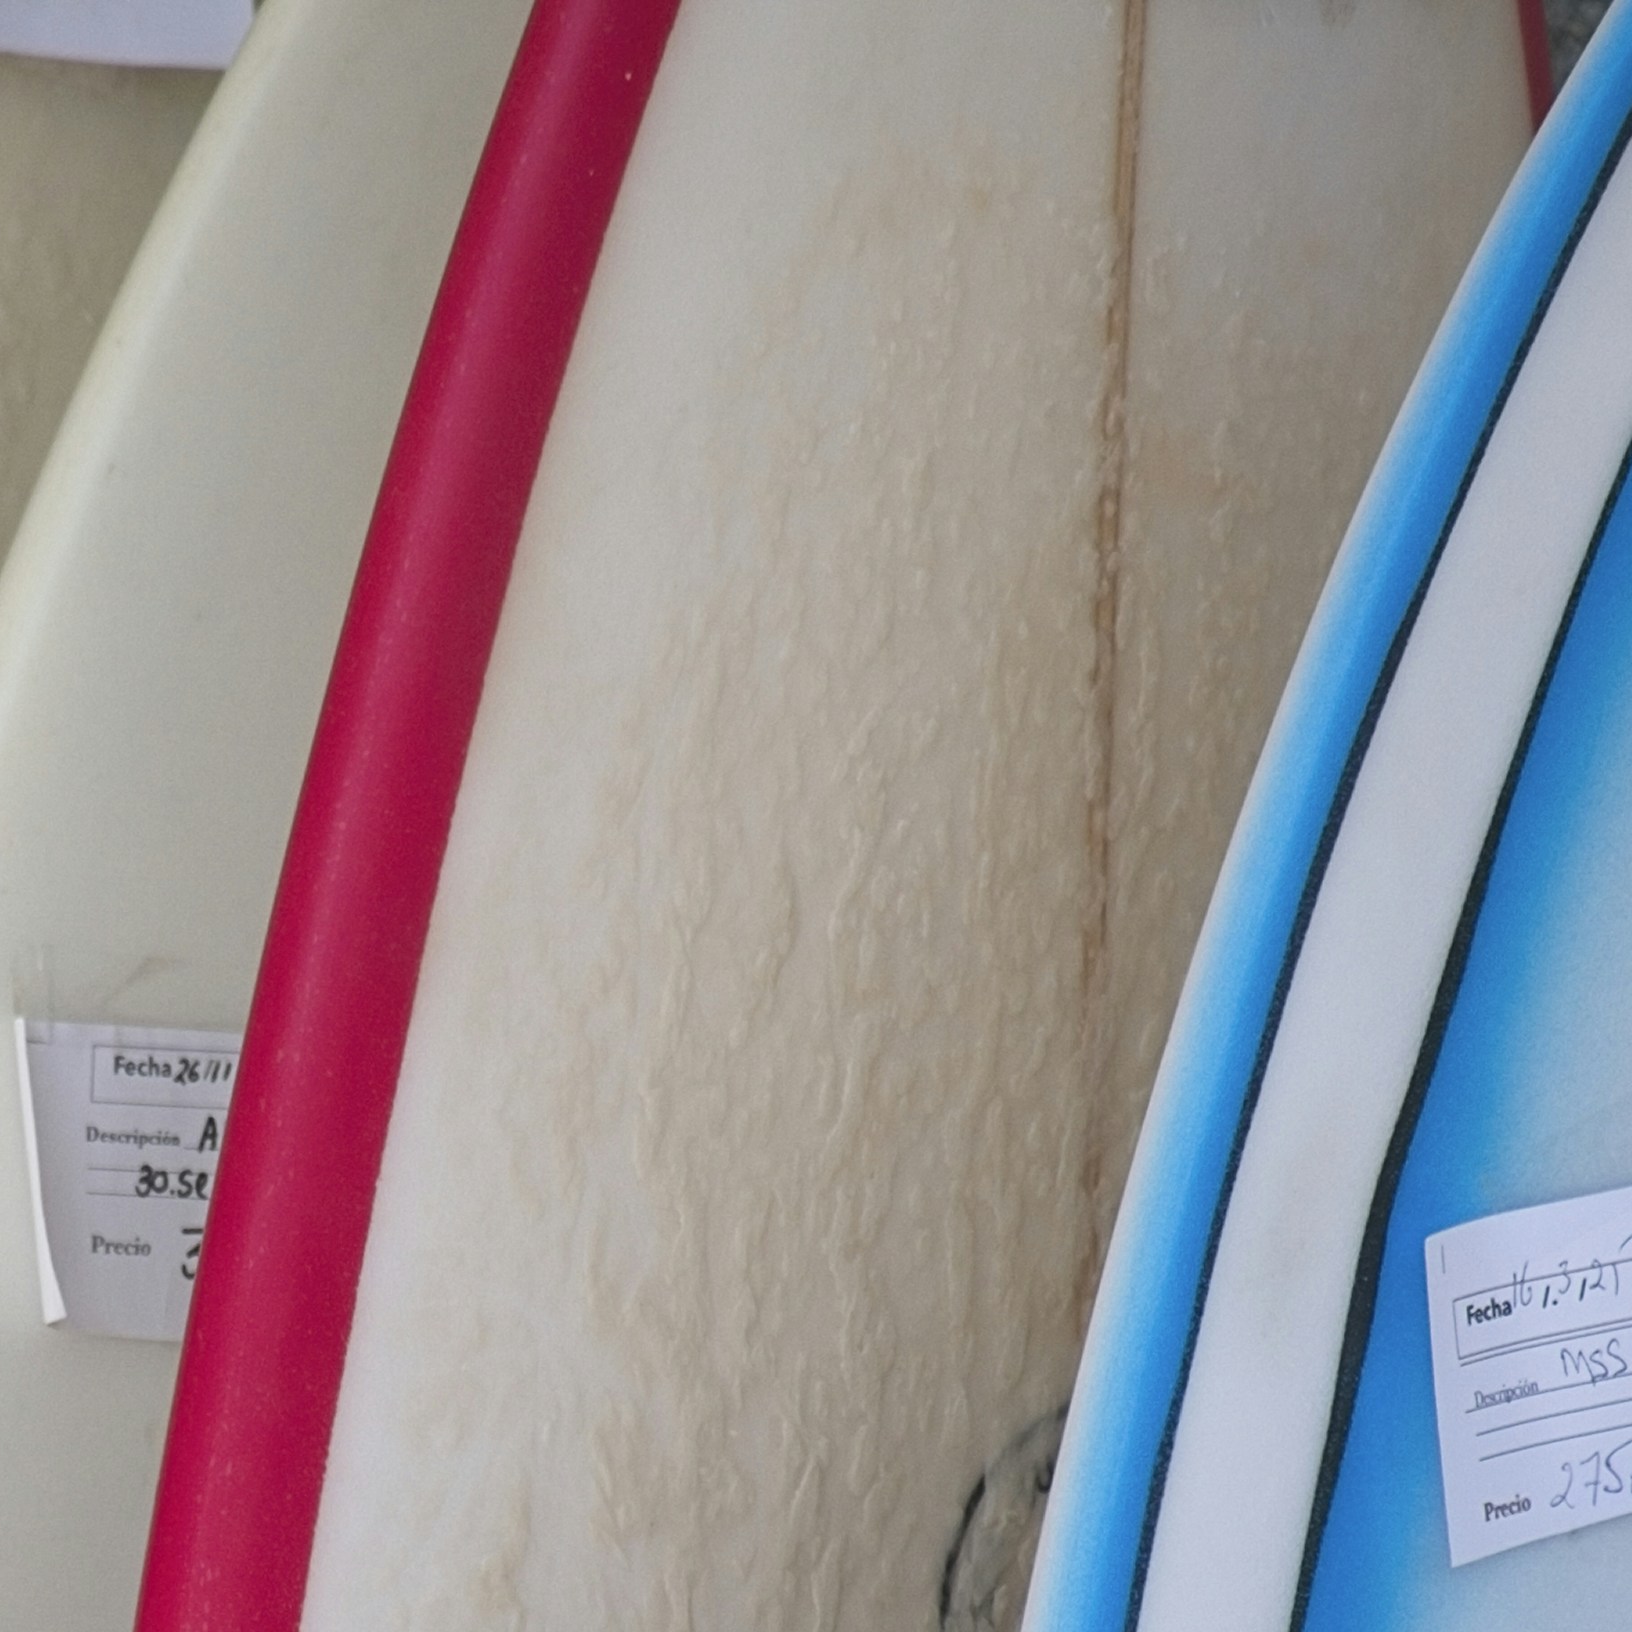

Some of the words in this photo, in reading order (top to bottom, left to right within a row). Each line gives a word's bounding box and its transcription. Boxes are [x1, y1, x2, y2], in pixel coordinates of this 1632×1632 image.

[113, 1055, 172, 1078] Fecha
[85, 1126, 181, 1150] Descripción
[90, 1234, 152, 1257] Precio
[1466, 1297, 1513, 1327] Fecha
[1473, 1378, 1540, 1408] Descripción
[1560, 1338, 1628, 1388] MSS
[1483, 1494, 1532, 1523] Precio
